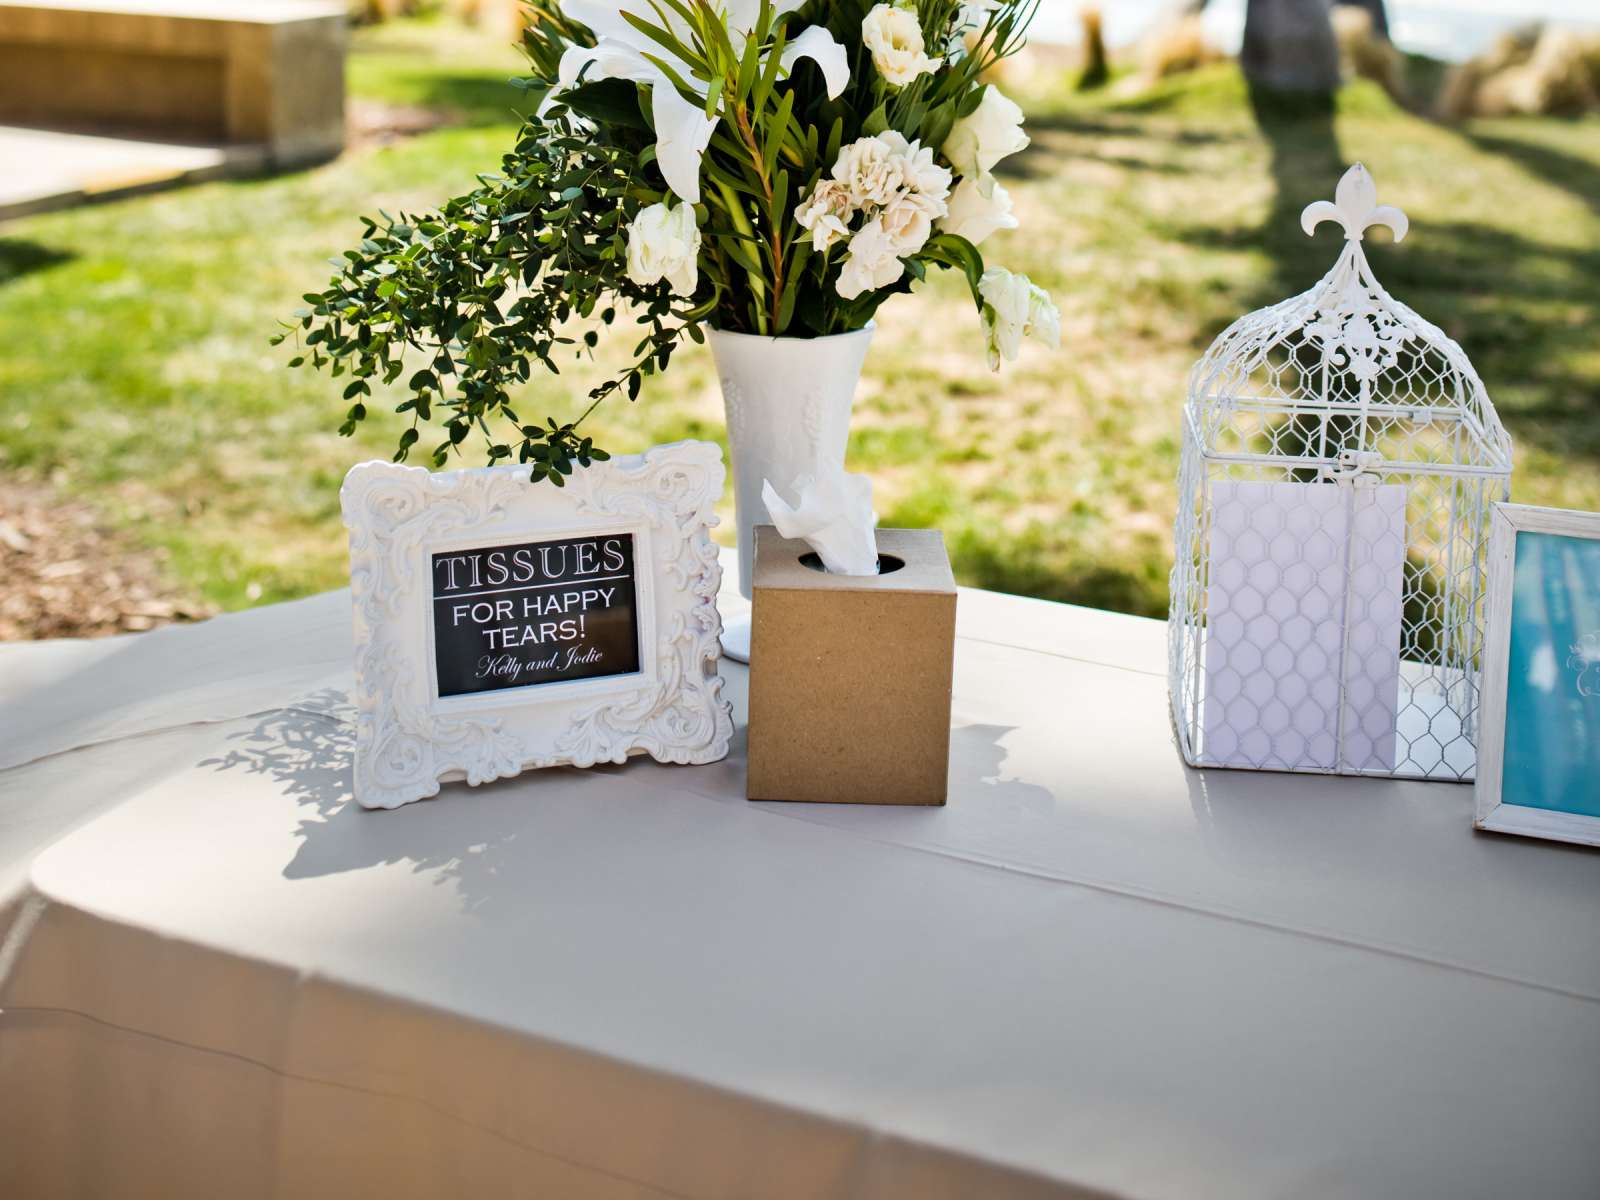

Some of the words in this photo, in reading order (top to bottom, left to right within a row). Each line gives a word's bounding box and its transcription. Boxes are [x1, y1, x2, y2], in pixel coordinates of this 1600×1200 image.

[436, 539, 625, 590] TISSUES
[452, 600, 514, 626] FOR
[523, 587, 616, 617] HAPPY
[482, 614, 585, 649] TEARS!
[475, 655, 522, 680] Kelly
[526, 652, 558, 671] and
[556, 644, 603, 672] Jodie
